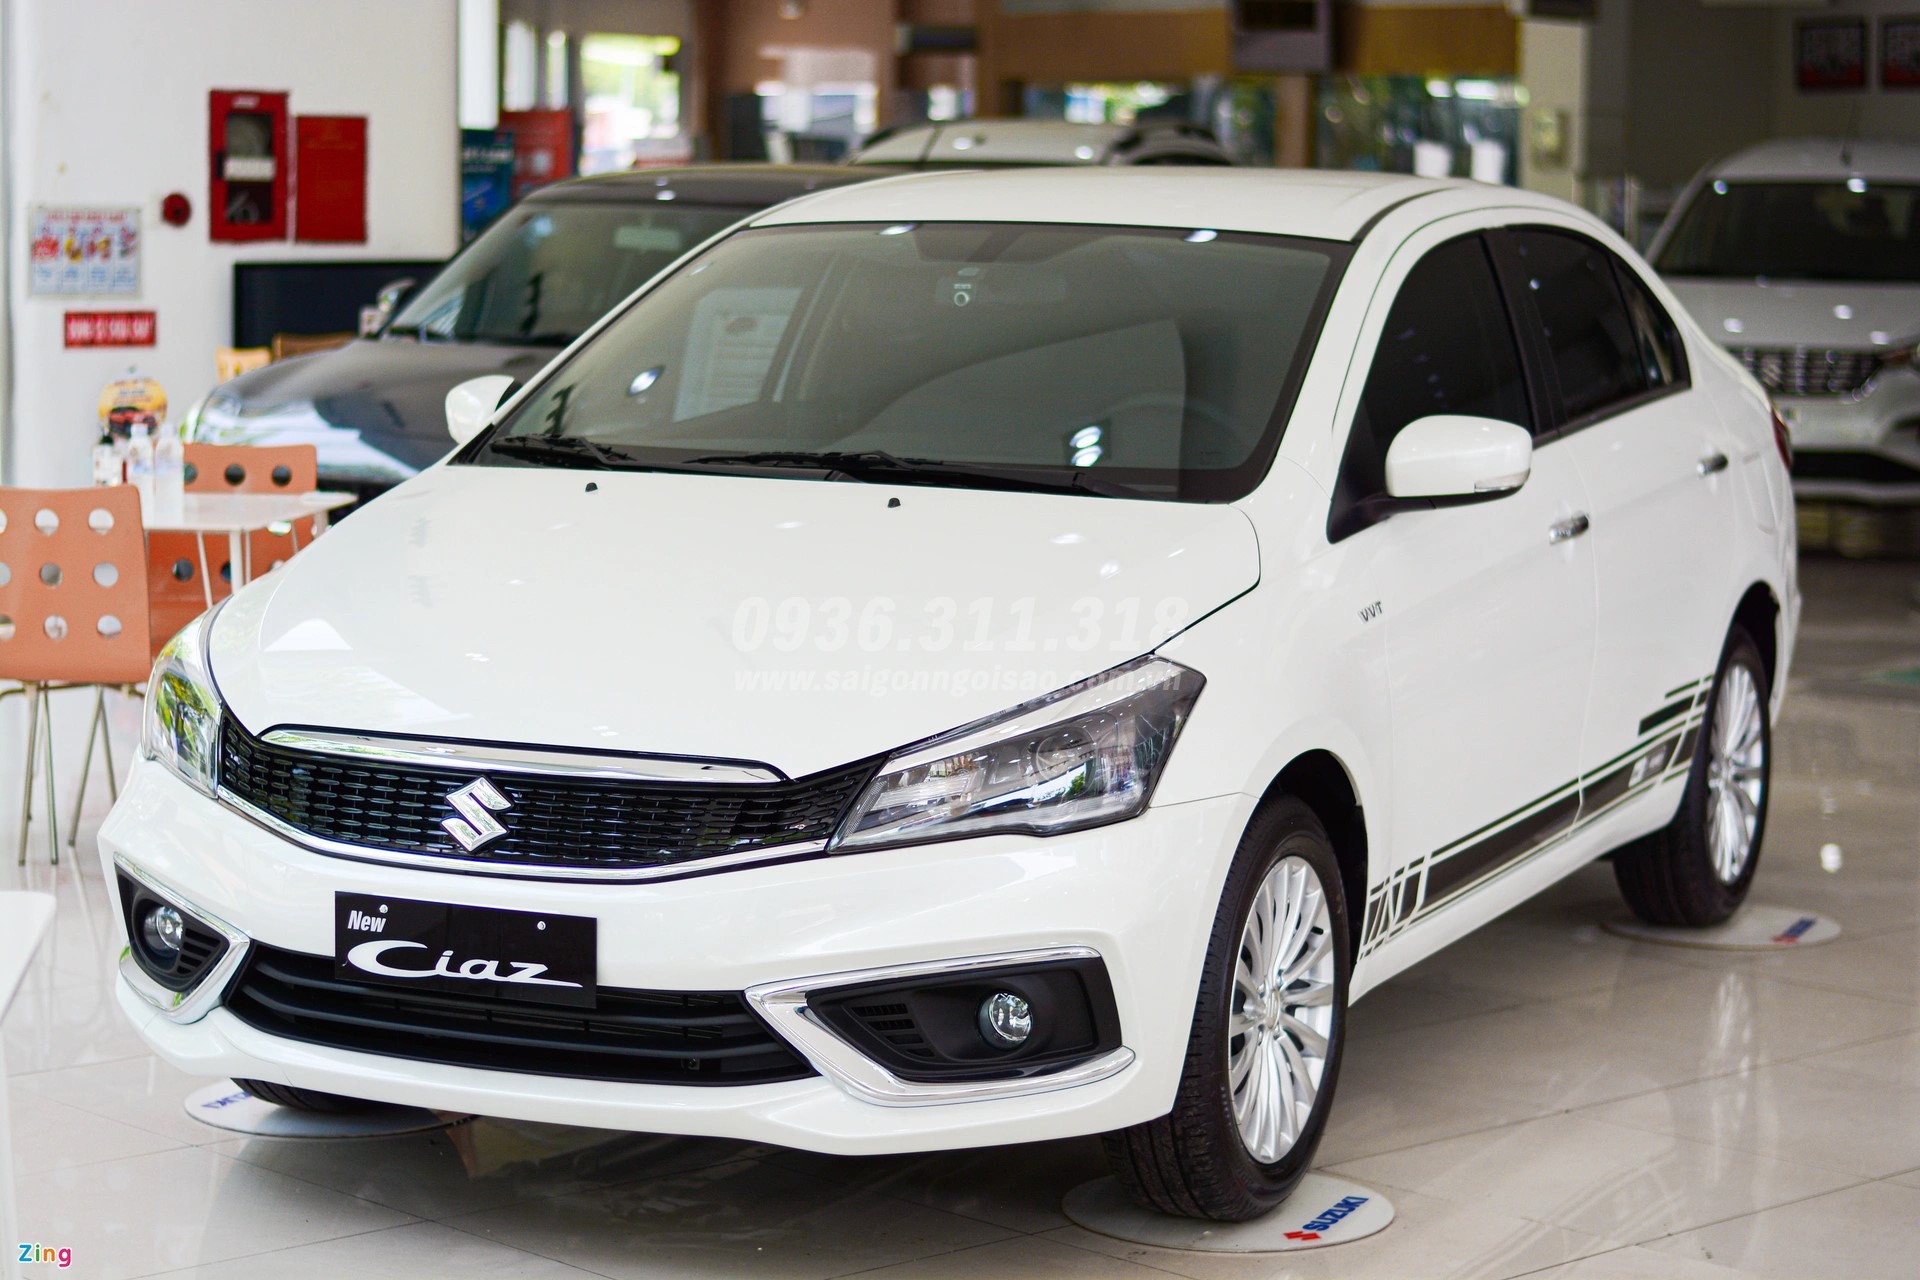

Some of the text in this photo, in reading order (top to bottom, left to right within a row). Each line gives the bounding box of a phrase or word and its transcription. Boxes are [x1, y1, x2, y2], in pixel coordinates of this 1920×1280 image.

[1358, 600, 1382, 622] VVT
[347, 910, 386, 932] New
[347, 939, 584, 988] Ciaz
[1302, 1195, 1369, 1231] SUZUKI
